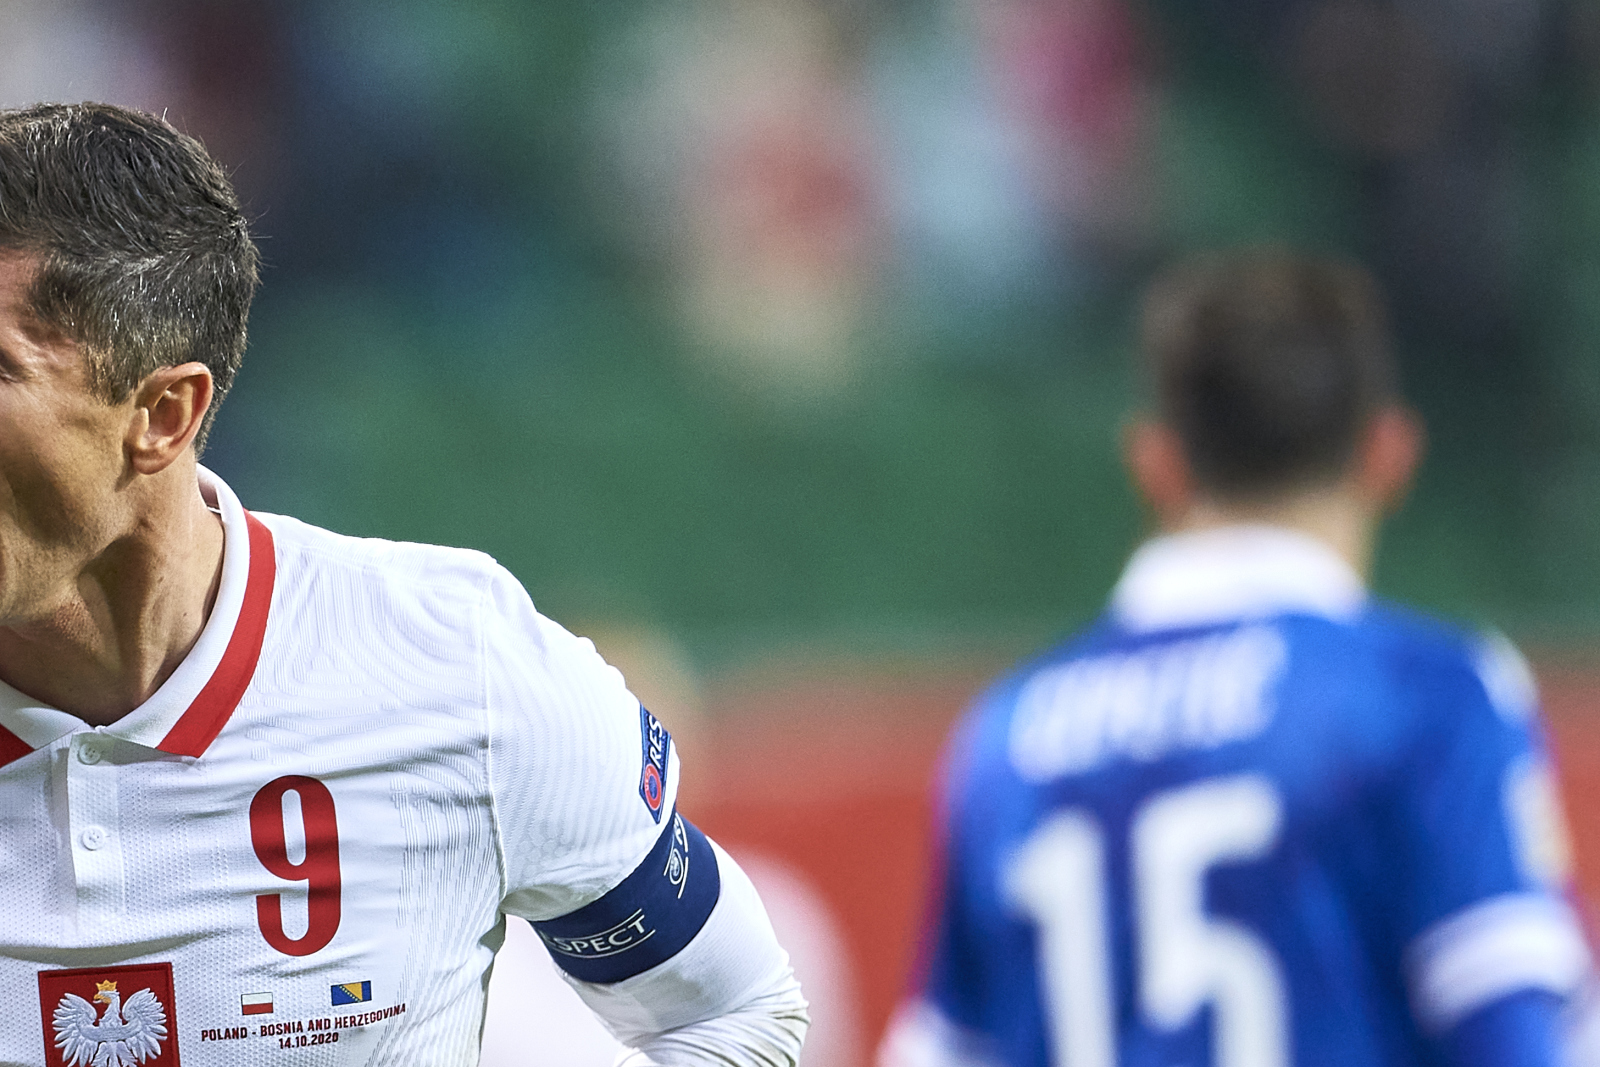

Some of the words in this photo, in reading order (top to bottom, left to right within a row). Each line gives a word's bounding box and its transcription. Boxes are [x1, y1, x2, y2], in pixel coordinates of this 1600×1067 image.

[249, 775, 341, 956] 9
[201, 1027, 248, 1042] POLAND
[260, 1021, 303, 1037] BOSNIA
[308, 1018, 331, 1031] AND
[335, 1003, 406, 1029] HERZEGOVINA
[279, 1032, 339, 1049] 14.10.2020
